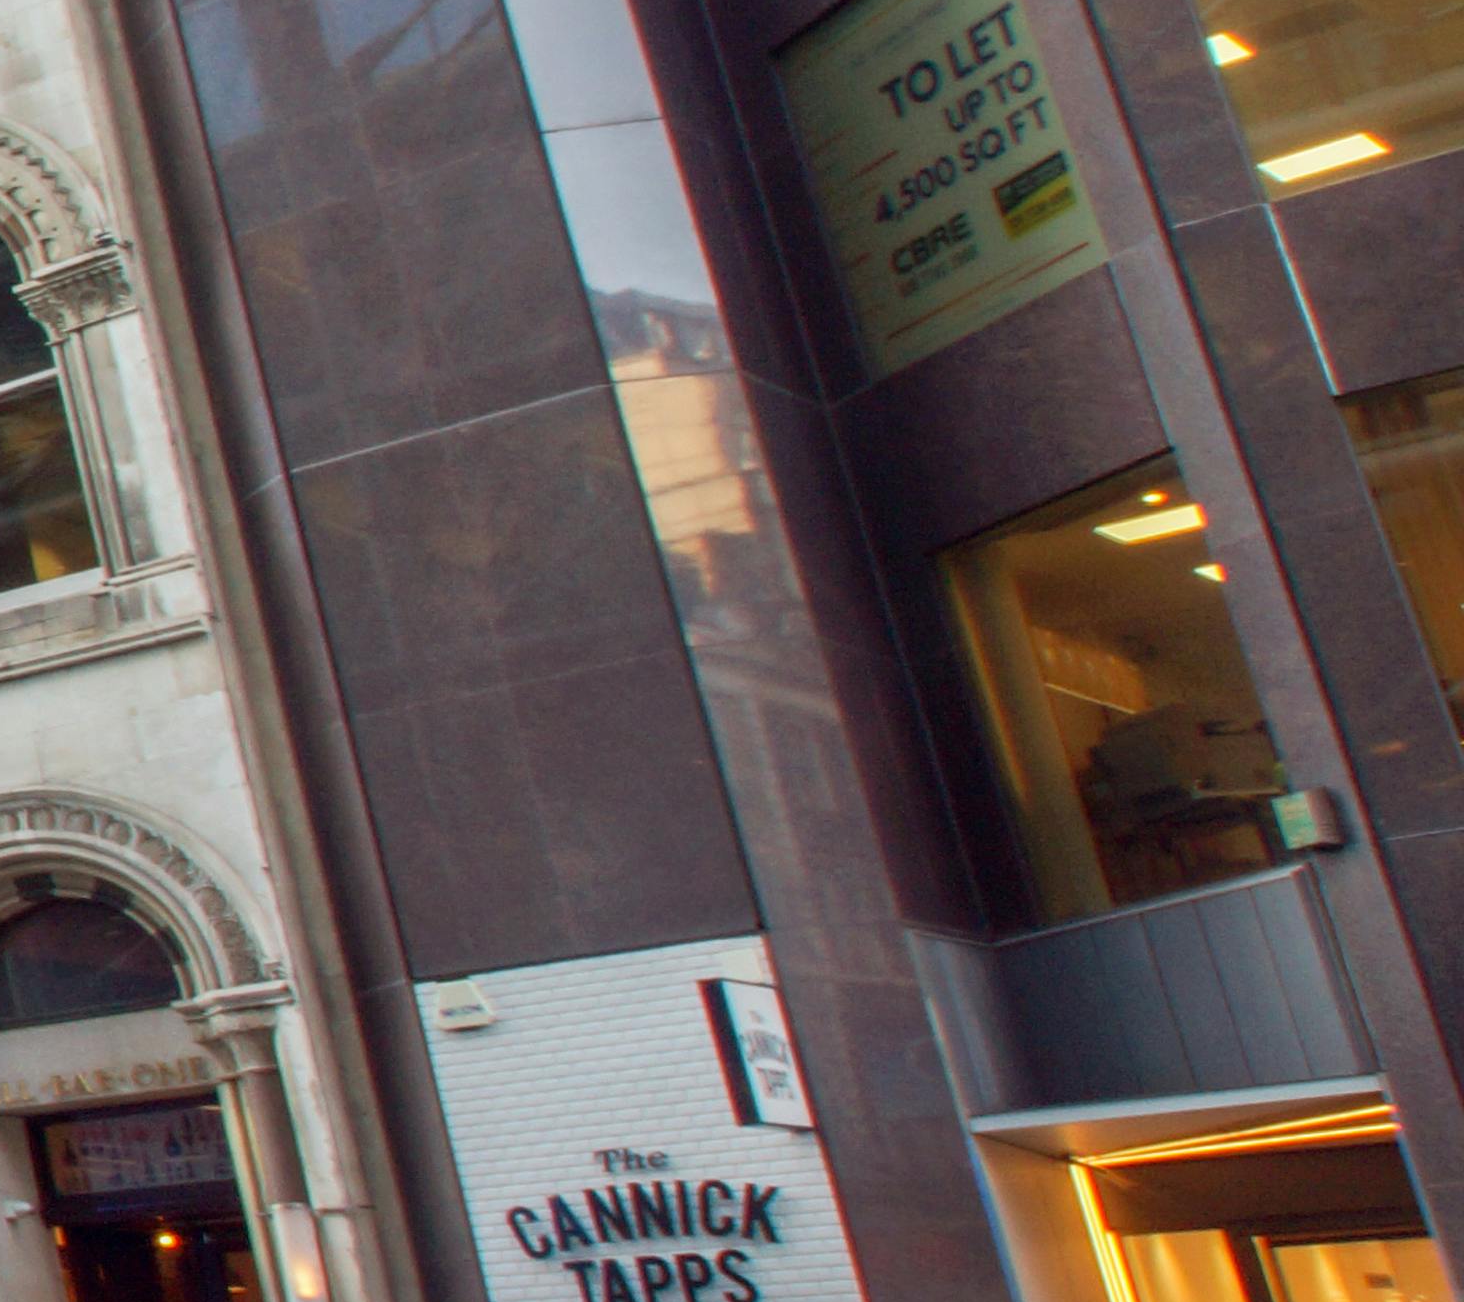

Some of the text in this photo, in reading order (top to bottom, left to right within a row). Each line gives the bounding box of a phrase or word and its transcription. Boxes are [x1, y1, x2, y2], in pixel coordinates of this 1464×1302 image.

[879, 59, 943, 119] TO
[944, 1, 1017, 82] LET
[944, 60, 1036, 134] UP TO
[959, 126, 1007, 173] SQ
[1006, 97, 1048, 146] FT
[593, 1147, 670, 1173] The
[505, 1179, 784, 1261] CANNICK
